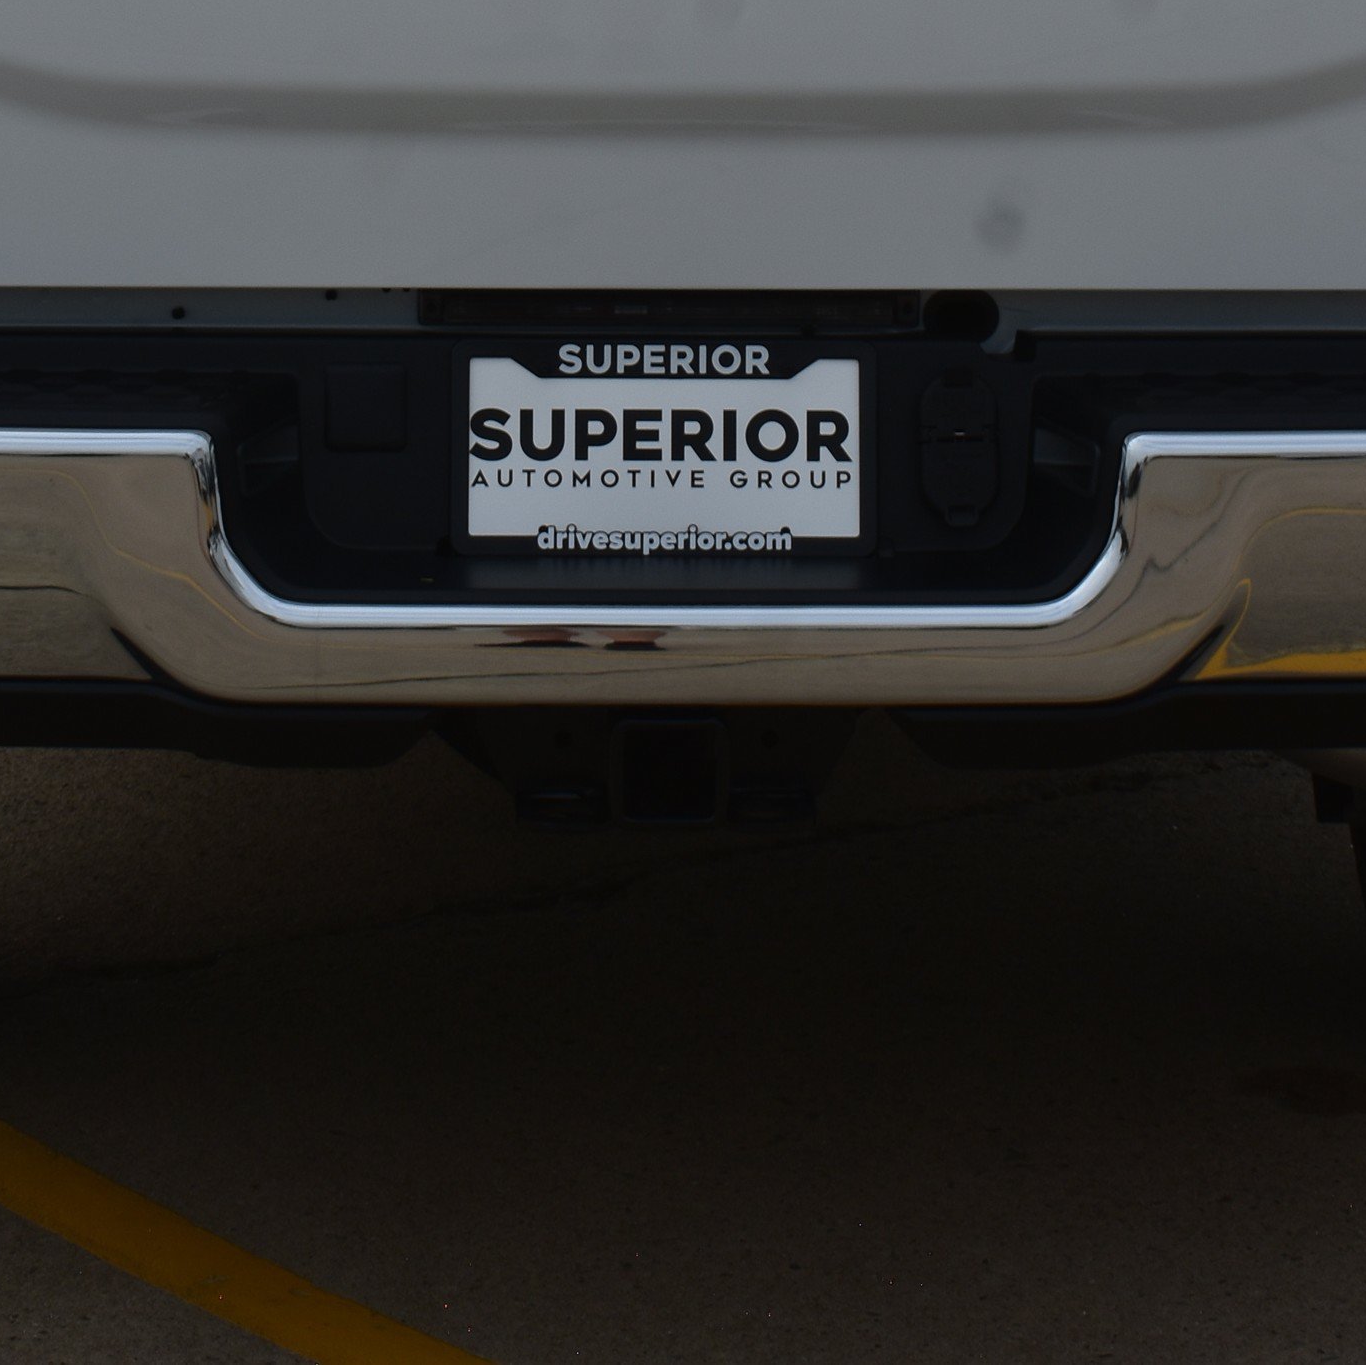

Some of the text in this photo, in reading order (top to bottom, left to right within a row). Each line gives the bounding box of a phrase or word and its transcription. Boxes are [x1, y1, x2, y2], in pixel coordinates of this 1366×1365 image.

[558, 344, 770, 375] SUPERIOR
[469, 408, 852, 462] SUPERIOR
[471, 469, 852, 489] AUTOMOTIVE GROUP
[537, 524, 793, 555] drivesuperior.com
